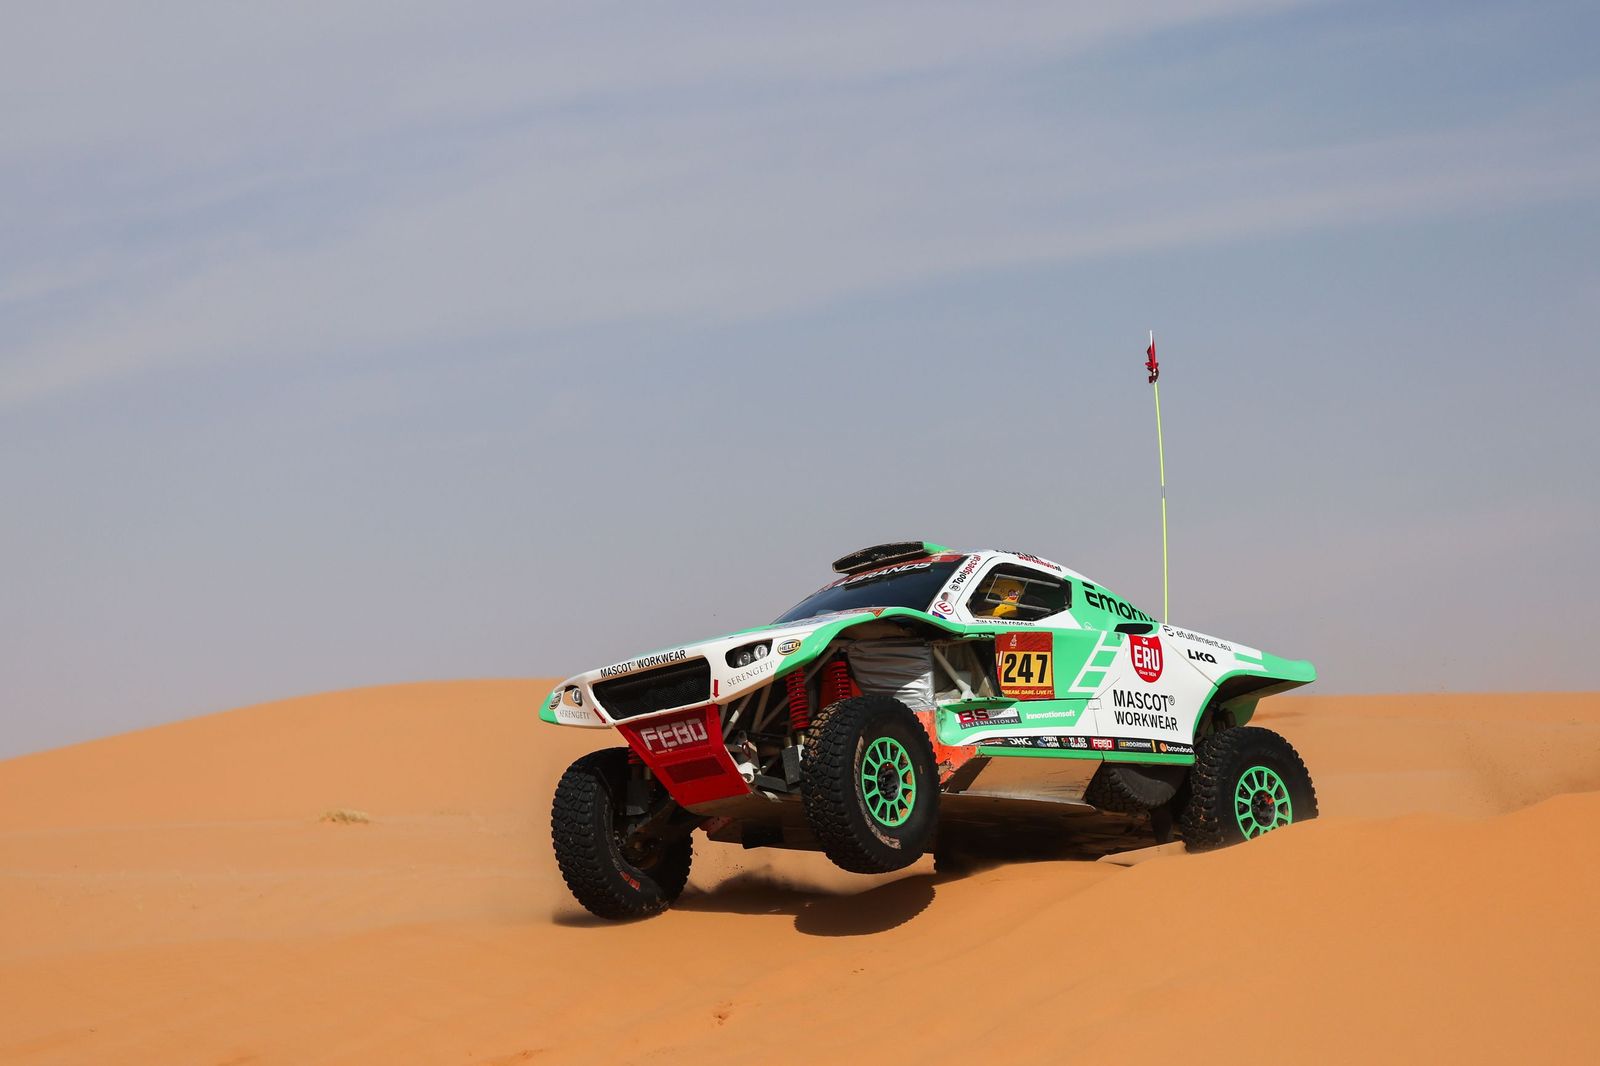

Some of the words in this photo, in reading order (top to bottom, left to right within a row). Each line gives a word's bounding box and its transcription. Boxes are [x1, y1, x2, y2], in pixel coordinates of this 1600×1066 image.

[952, 554, 981, 585] Toolspecial
[938, 602, 952, 613] E
[637, 650, 686, 668] WORKWEAR
[1134, 645, 1160, 671] ERU
[1187, 649, 1217, 664] LKQ
[1003, 653, 1048, 683] 247
[960, 708, 990, 722] BS
[961, 718, 1018, 729] INTERNATIONAL
[1114, 711, 1178, 731] WORKWEAR
[640, 718, 708, 750] FEBO
